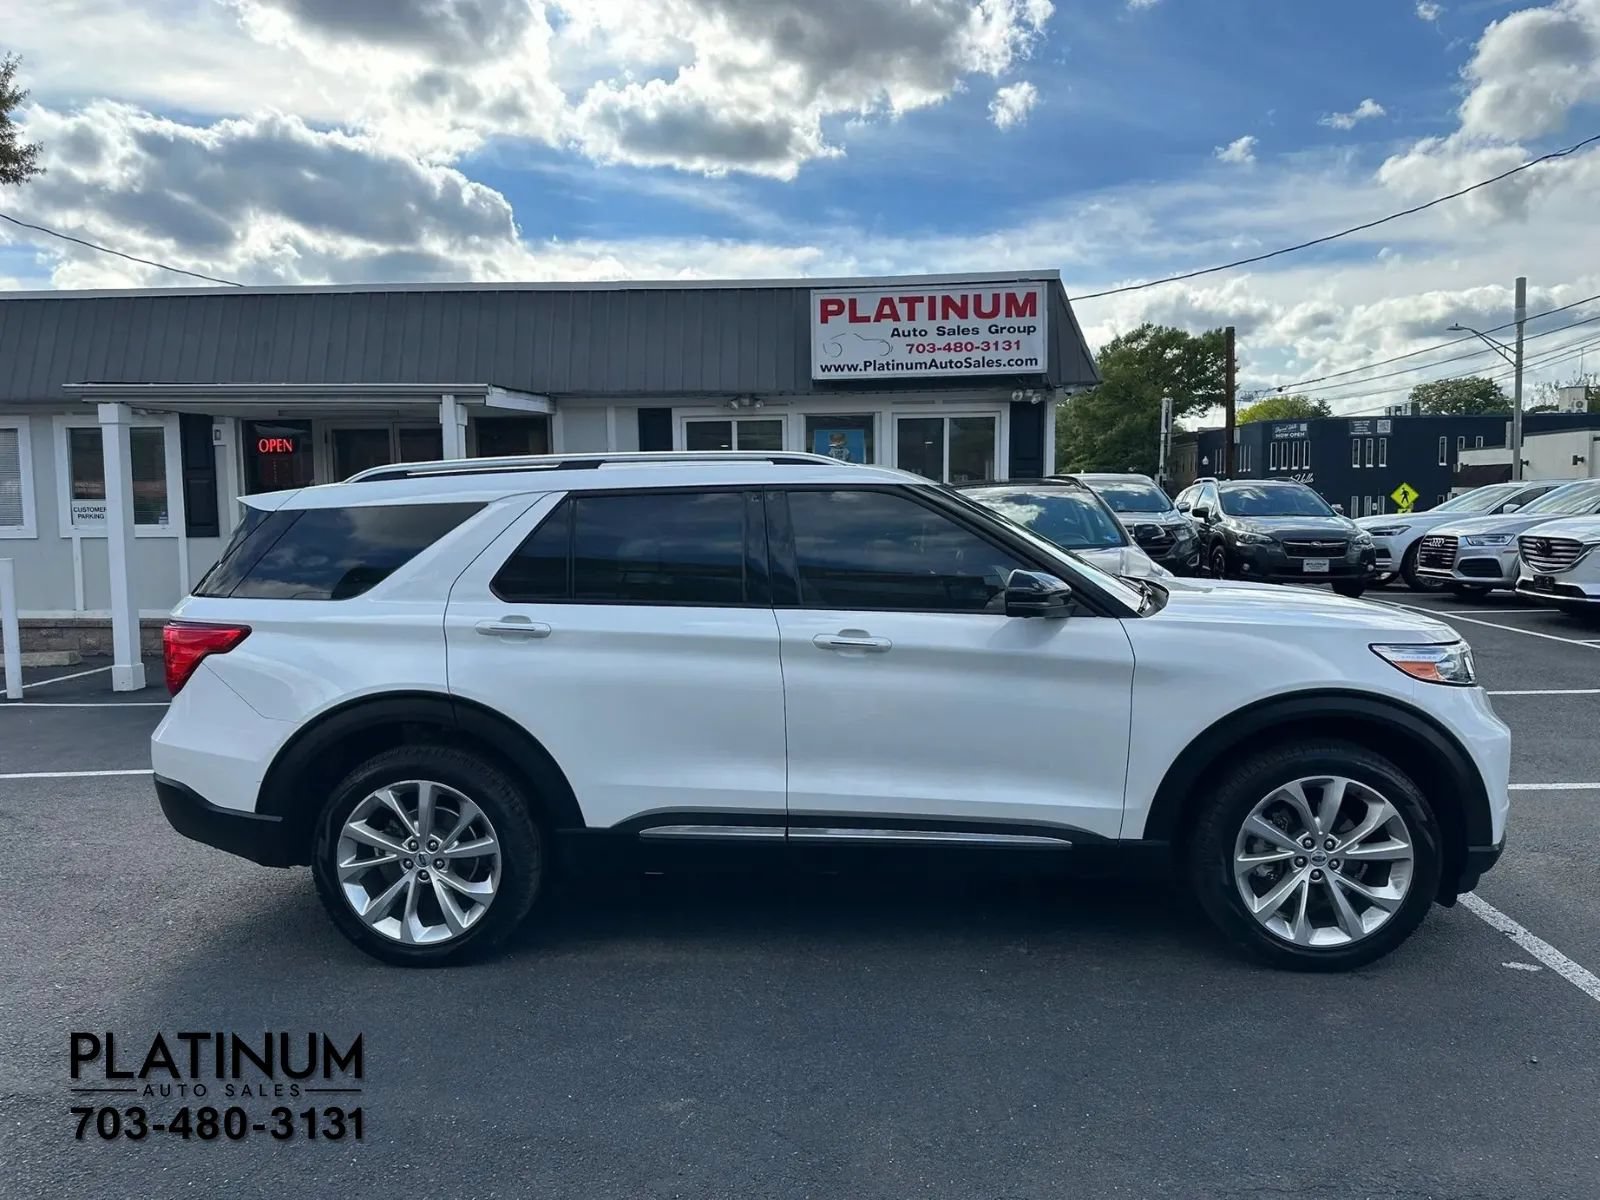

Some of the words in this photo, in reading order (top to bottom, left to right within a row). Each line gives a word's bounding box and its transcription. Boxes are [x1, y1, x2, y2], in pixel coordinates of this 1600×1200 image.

[819, 291, 1037, 324] PLATINUM
[890, 327, 928, 338] Auto
[936, 325, 980, 337] Sales
[987, 324, 1037, 336] Group
[905, 339, 1021, 354] 703-480-3131
[819, 356, 1038, 373] www.PlatinumAutoSales.com
[258, 438, 293, 453] OPEN
